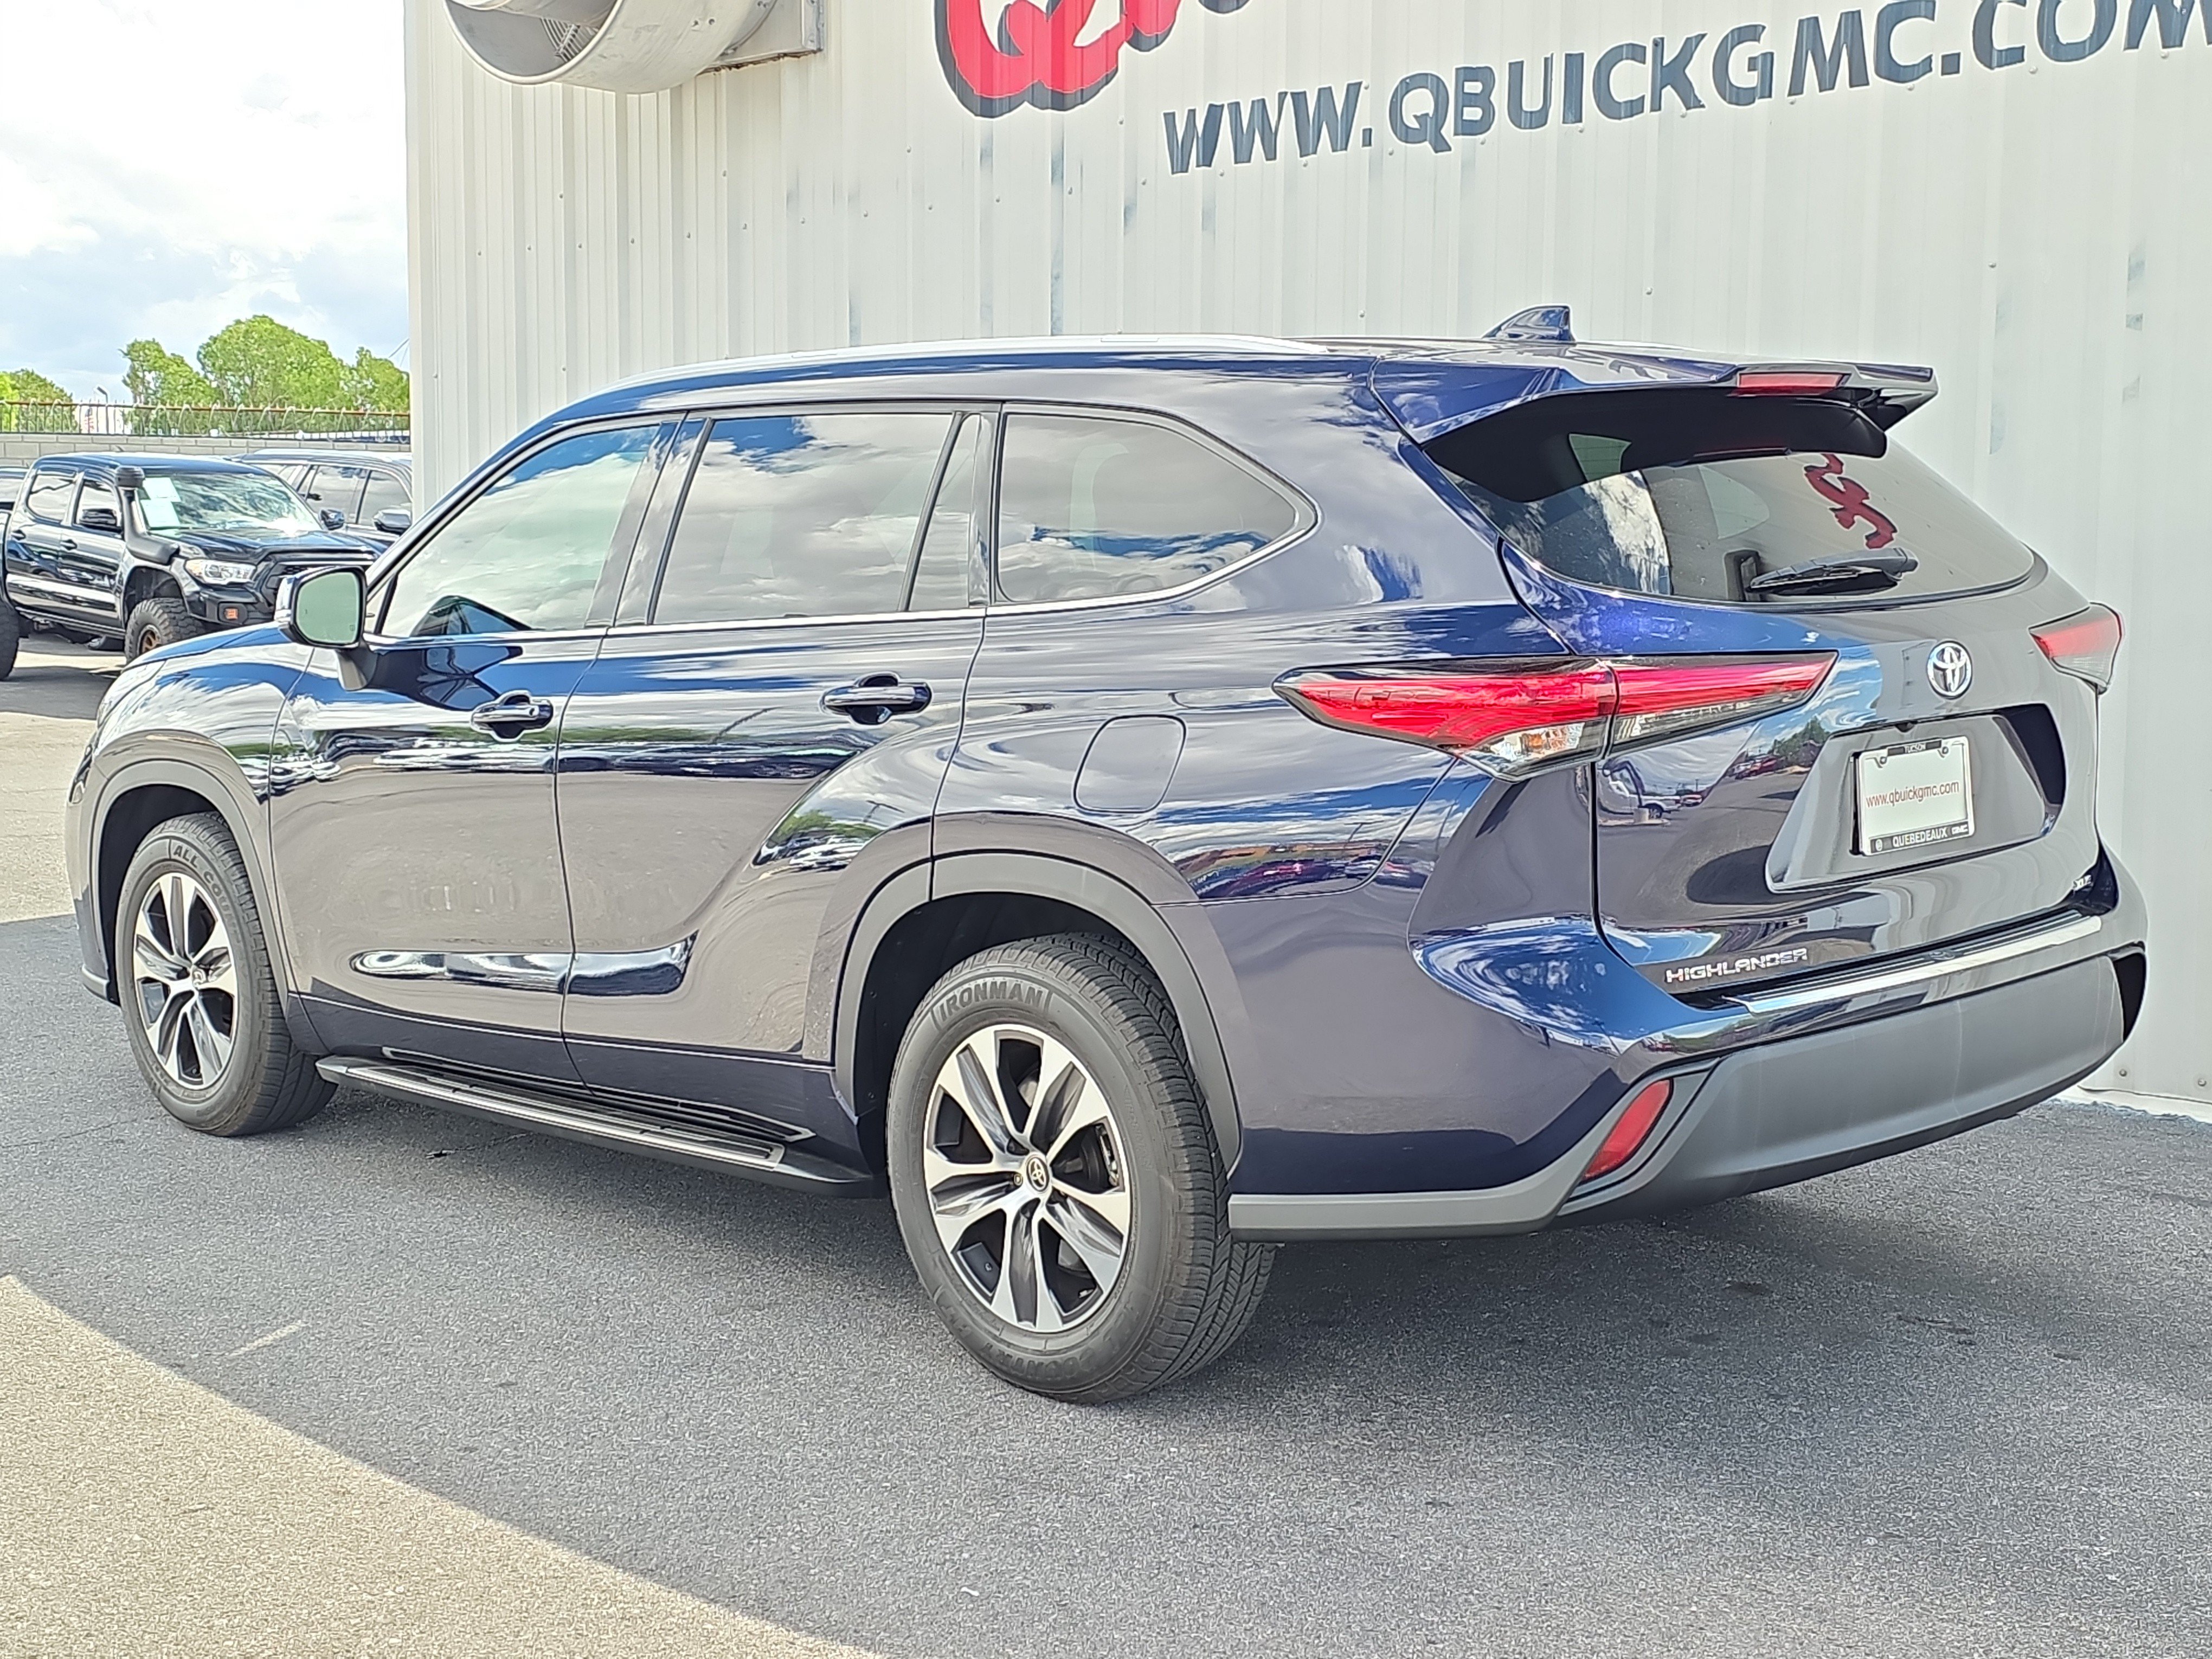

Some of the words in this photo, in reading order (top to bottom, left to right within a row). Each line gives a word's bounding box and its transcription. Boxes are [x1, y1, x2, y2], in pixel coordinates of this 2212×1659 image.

[1905, 742, 1926, 753] TUCSON
[1866, 781, 1959, 807] www.qbuickgmc.com
[1893, 827, 1948, 847] QUEBEDEAUX
[173, 845, 198, 869] ALL
[1664, 948, 1808, 985] HIGHLANDER
[938, 979, 1045, 1020] IRONMAN
[980, 1342, 1097, 1380] COUNTRY
